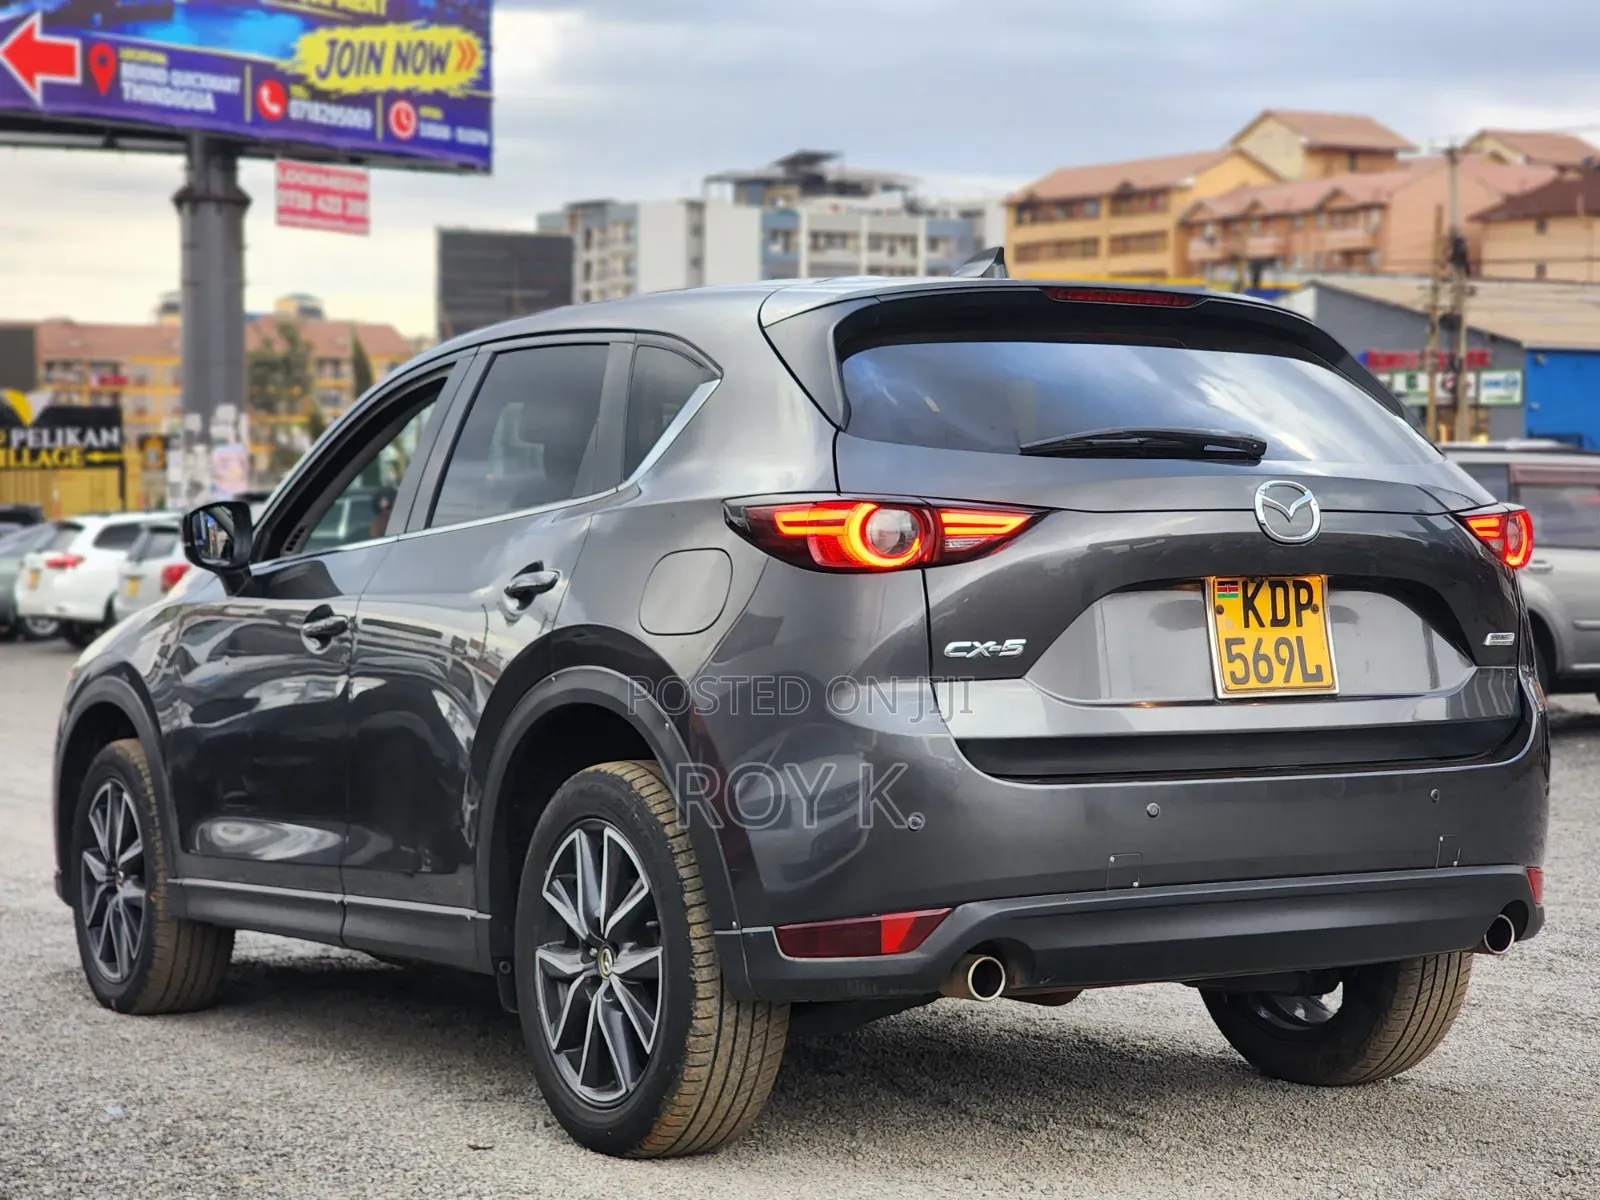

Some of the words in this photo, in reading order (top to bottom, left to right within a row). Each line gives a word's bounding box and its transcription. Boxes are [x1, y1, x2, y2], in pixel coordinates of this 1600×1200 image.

[314, 38, 387, 81] JOIN
[393, 39, 452, 77] NOW
[10, 427, 120, 449] PELIKAN
[1242, 579, 1314, 628] KDP
[943, 638, 1027, 658] CX-5
[1225, 635, 1324, 685] 569L
